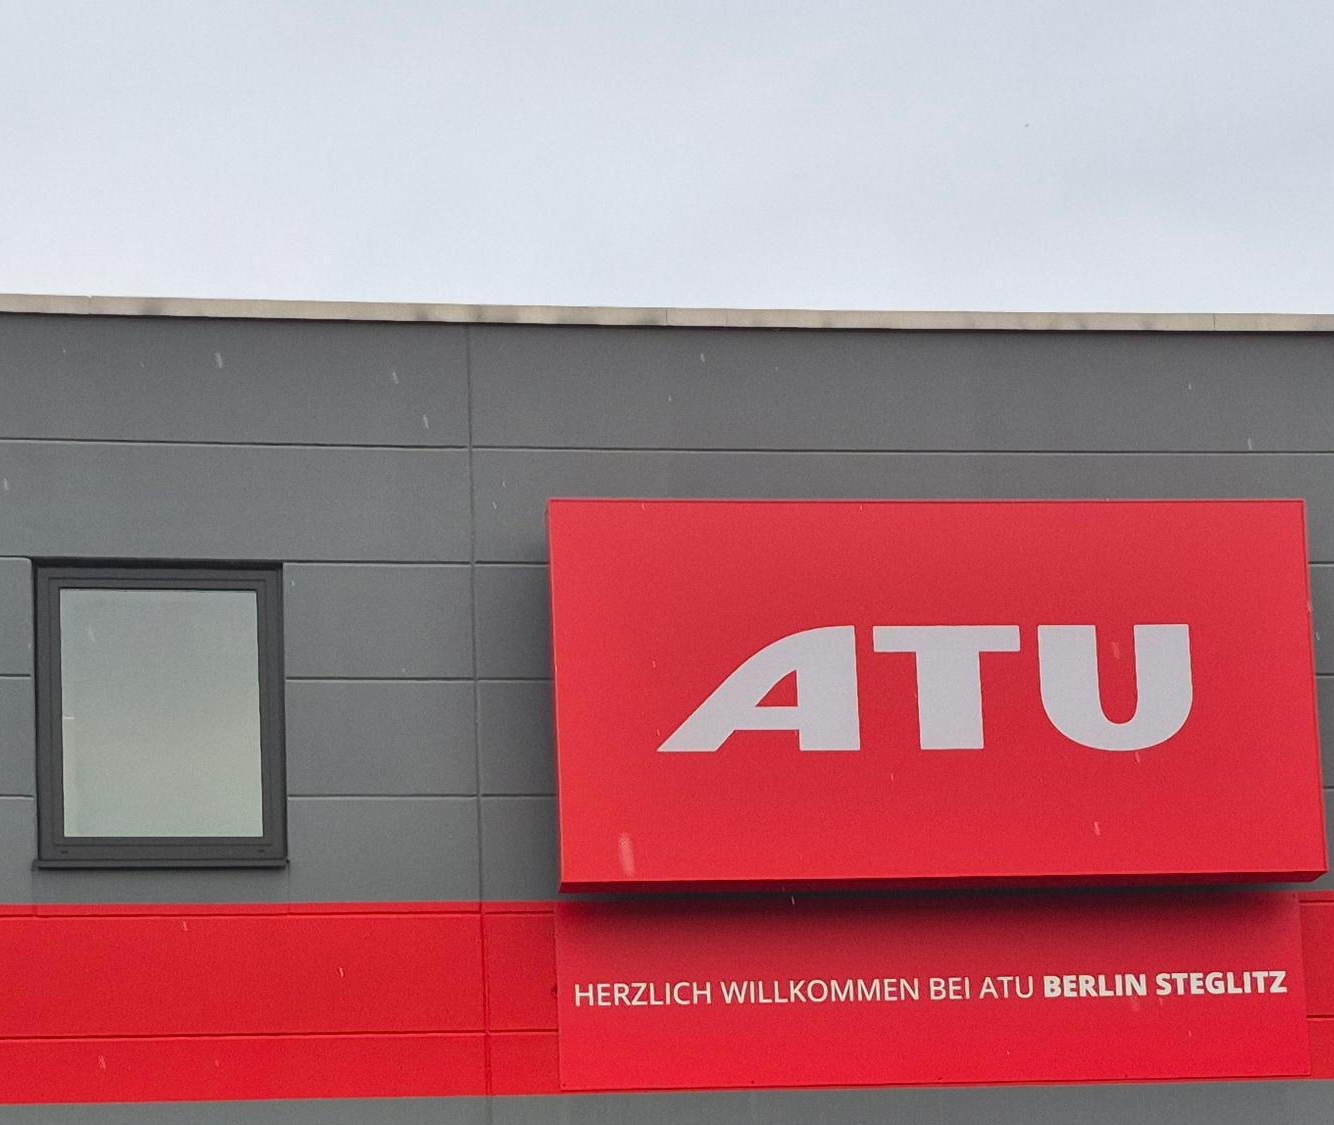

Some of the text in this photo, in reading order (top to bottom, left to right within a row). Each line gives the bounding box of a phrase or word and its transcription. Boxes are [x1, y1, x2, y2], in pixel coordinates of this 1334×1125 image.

[656, 623, 1193, 752] ATU
[574, 971, 1287, 1006] HERZLICH WILLKOMMEN BEI ATU BERLIN STEGLITZ
